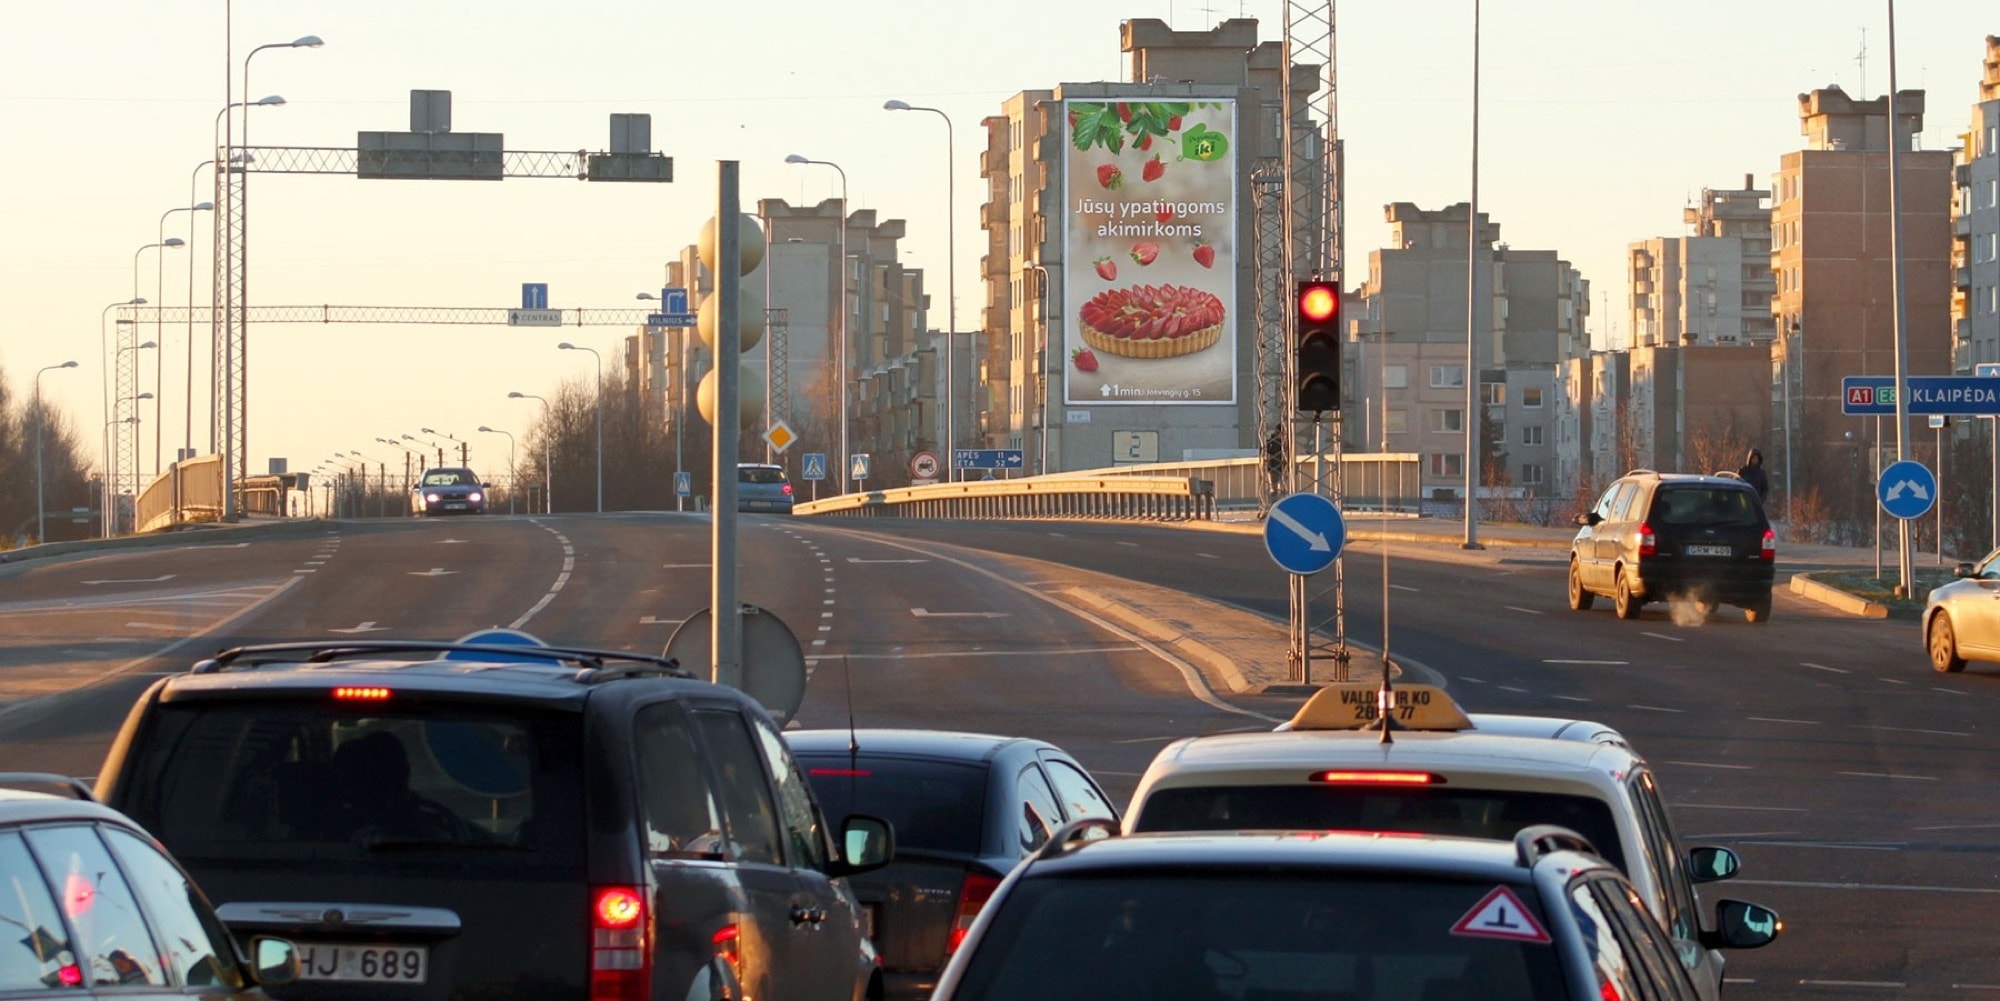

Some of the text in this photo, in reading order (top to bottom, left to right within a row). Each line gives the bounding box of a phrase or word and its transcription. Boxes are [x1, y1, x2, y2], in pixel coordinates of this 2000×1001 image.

[1194, 141, 1215, 156] iki
[1075, 198, 1225, 218] Jūsų ypatingoms
[1097, 221, 1202, 237] akimirkoms
[521, 314, 560, 322] CENTRAS
[650, 315, 683, 325] VILNIUS
[1192, 388, 1201, 397] 15
[1851, 387, 1996, 402] A1 E8 KLAIPĖDA
[997, 451, 1005, 459] 11
[1412, 691, 1430, 705] KO
[361, 949, 420, 979] 689
